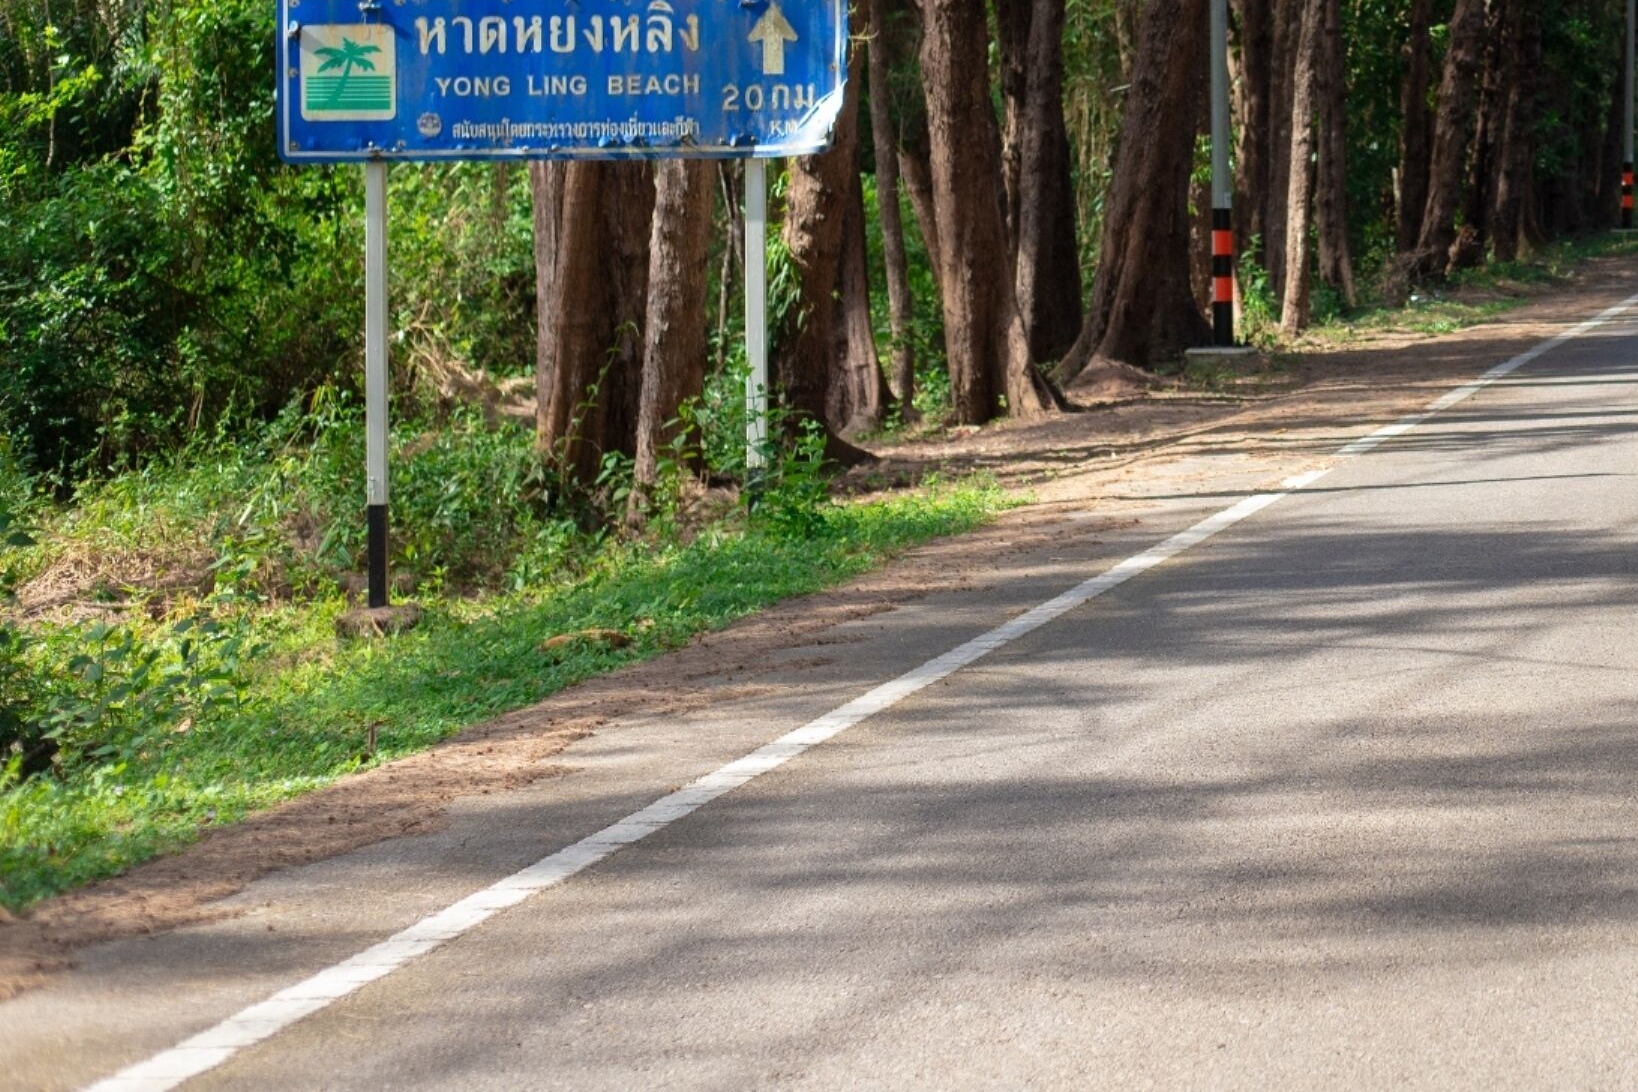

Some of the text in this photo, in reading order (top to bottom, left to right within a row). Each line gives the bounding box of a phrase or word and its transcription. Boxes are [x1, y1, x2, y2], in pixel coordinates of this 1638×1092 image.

[415, 0, 700, 55] หาดหยงหลิง
[435, 74, 700, 97] YONG LING BEACH
